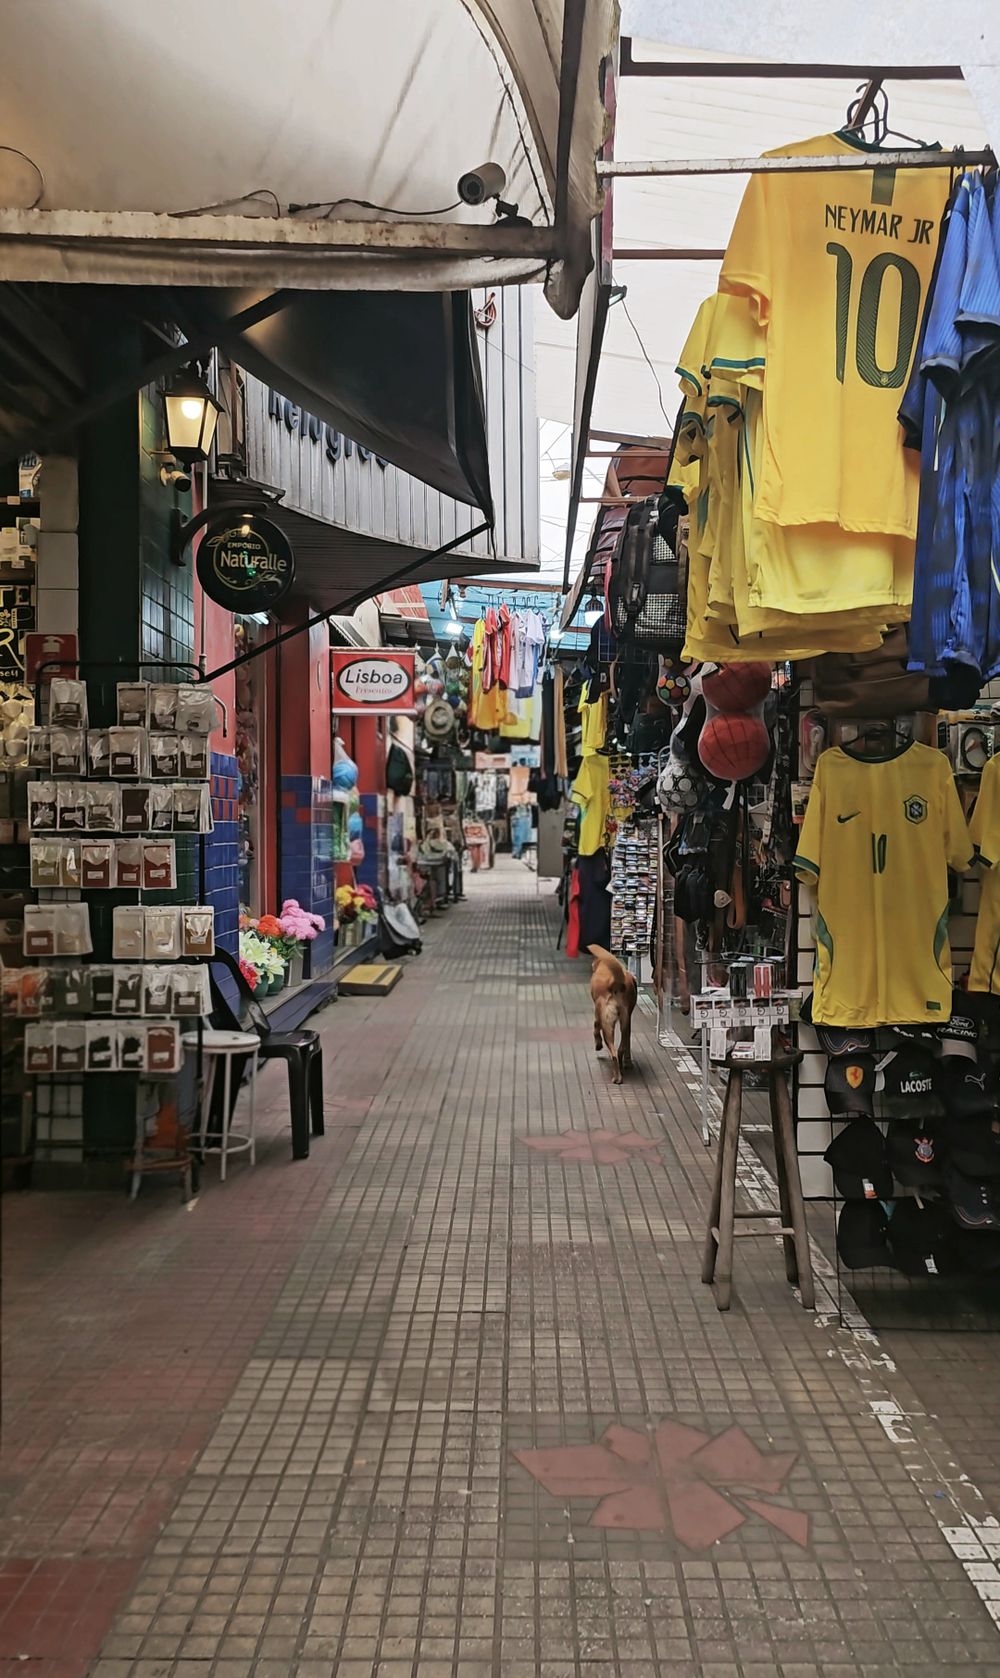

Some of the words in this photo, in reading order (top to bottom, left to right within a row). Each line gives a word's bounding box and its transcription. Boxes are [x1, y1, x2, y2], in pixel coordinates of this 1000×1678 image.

[825, 203, 903, 241] NEYMAR
[907, 218, 935, 245] JR
[825, 241, 922, 389] 10
[220, 550, 287, 572] Naturalle
[345, 669, 403, 684] Lisboa
[871, 832, 887, 874] 10
[936, 1027, 978, 1039] RACING
[900, 1078, 933, 1094] LACOSTE
